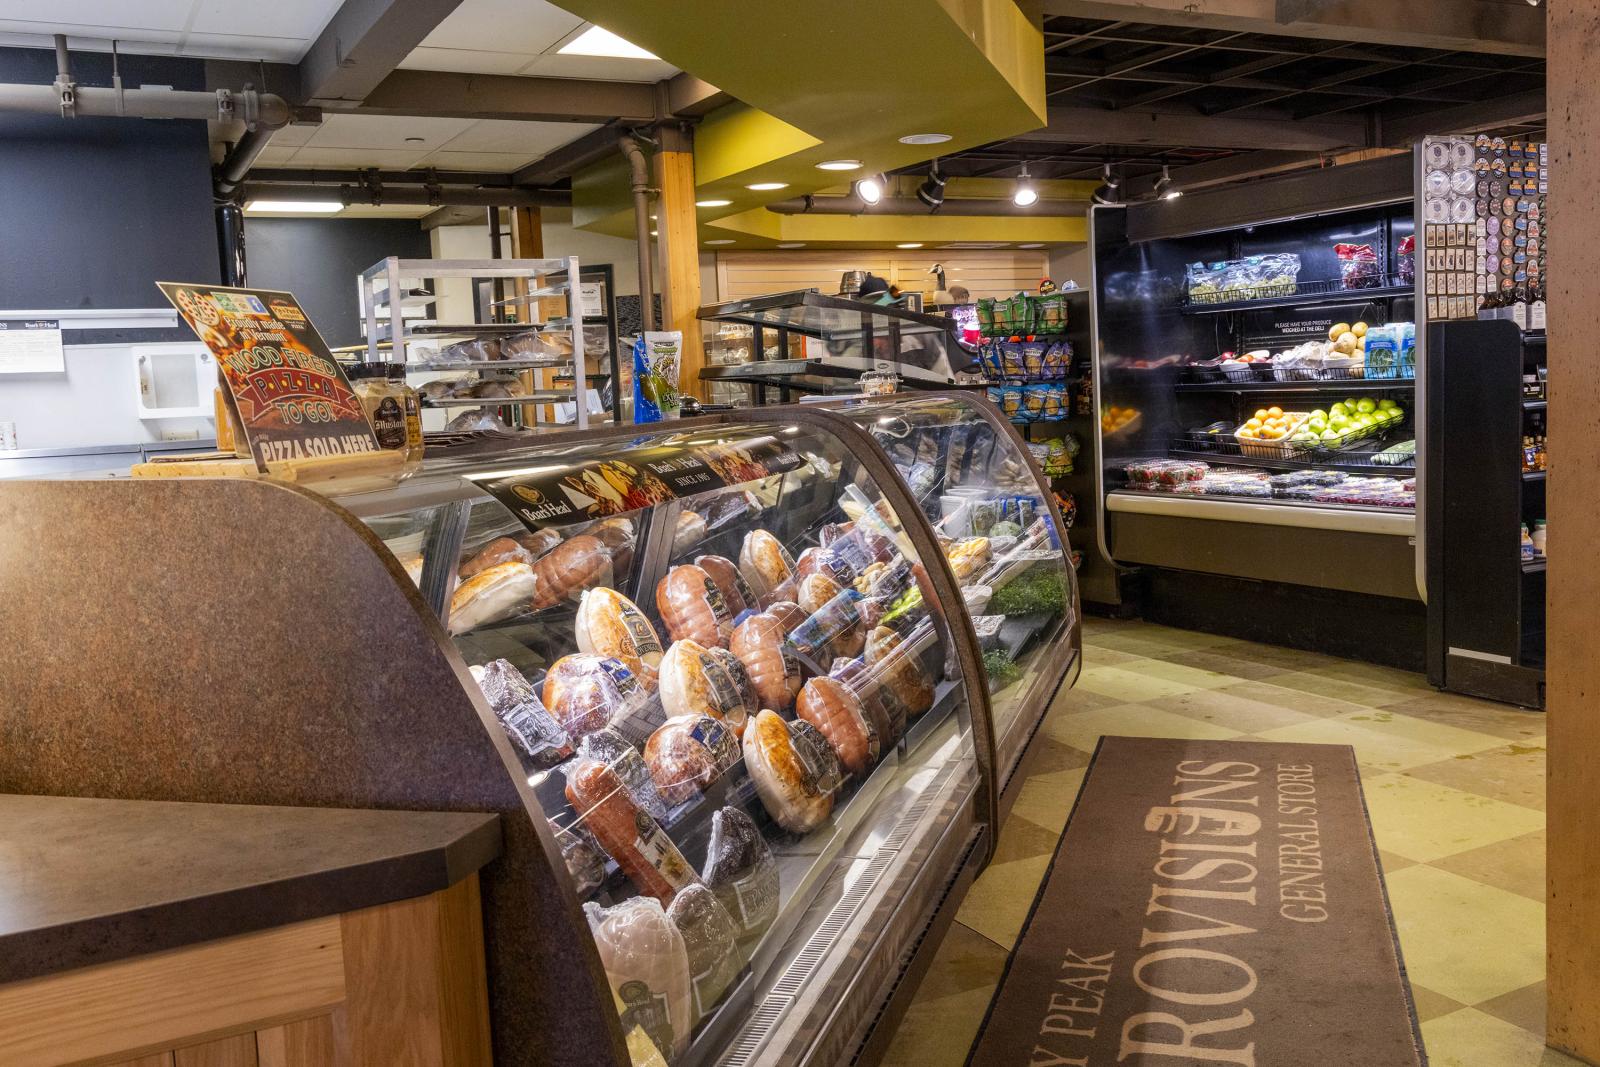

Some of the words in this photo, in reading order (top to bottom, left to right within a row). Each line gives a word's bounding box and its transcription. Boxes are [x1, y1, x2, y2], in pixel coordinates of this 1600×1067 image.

[223, 315, 262, 331] Proudly
[260, 318, 286, 330] made
[246, 329, 288, 342] Vermont
[225, 346, 283, 376] WOOD
[280, 347, 337, 378] FIRED
[276, 402, 303, 424] TO
[303, 401, 337, 423] GO!
[260, 440, 305, 463] PIZZA
[305, 437, 342, 459] SOLD
[341, 434, 377, 455] HERE
[676, 456, 703, 469] Head
[674, 475, 699, 487] SINCE
[520, 504, 553, 520] Boar's
[543, 500, 572, 516] Head
[1276, 763, 1318, 815] STORE
[1278, 817, 1329, 923] GENERAL
[1039, 948, 1116, 1040] PEAK
